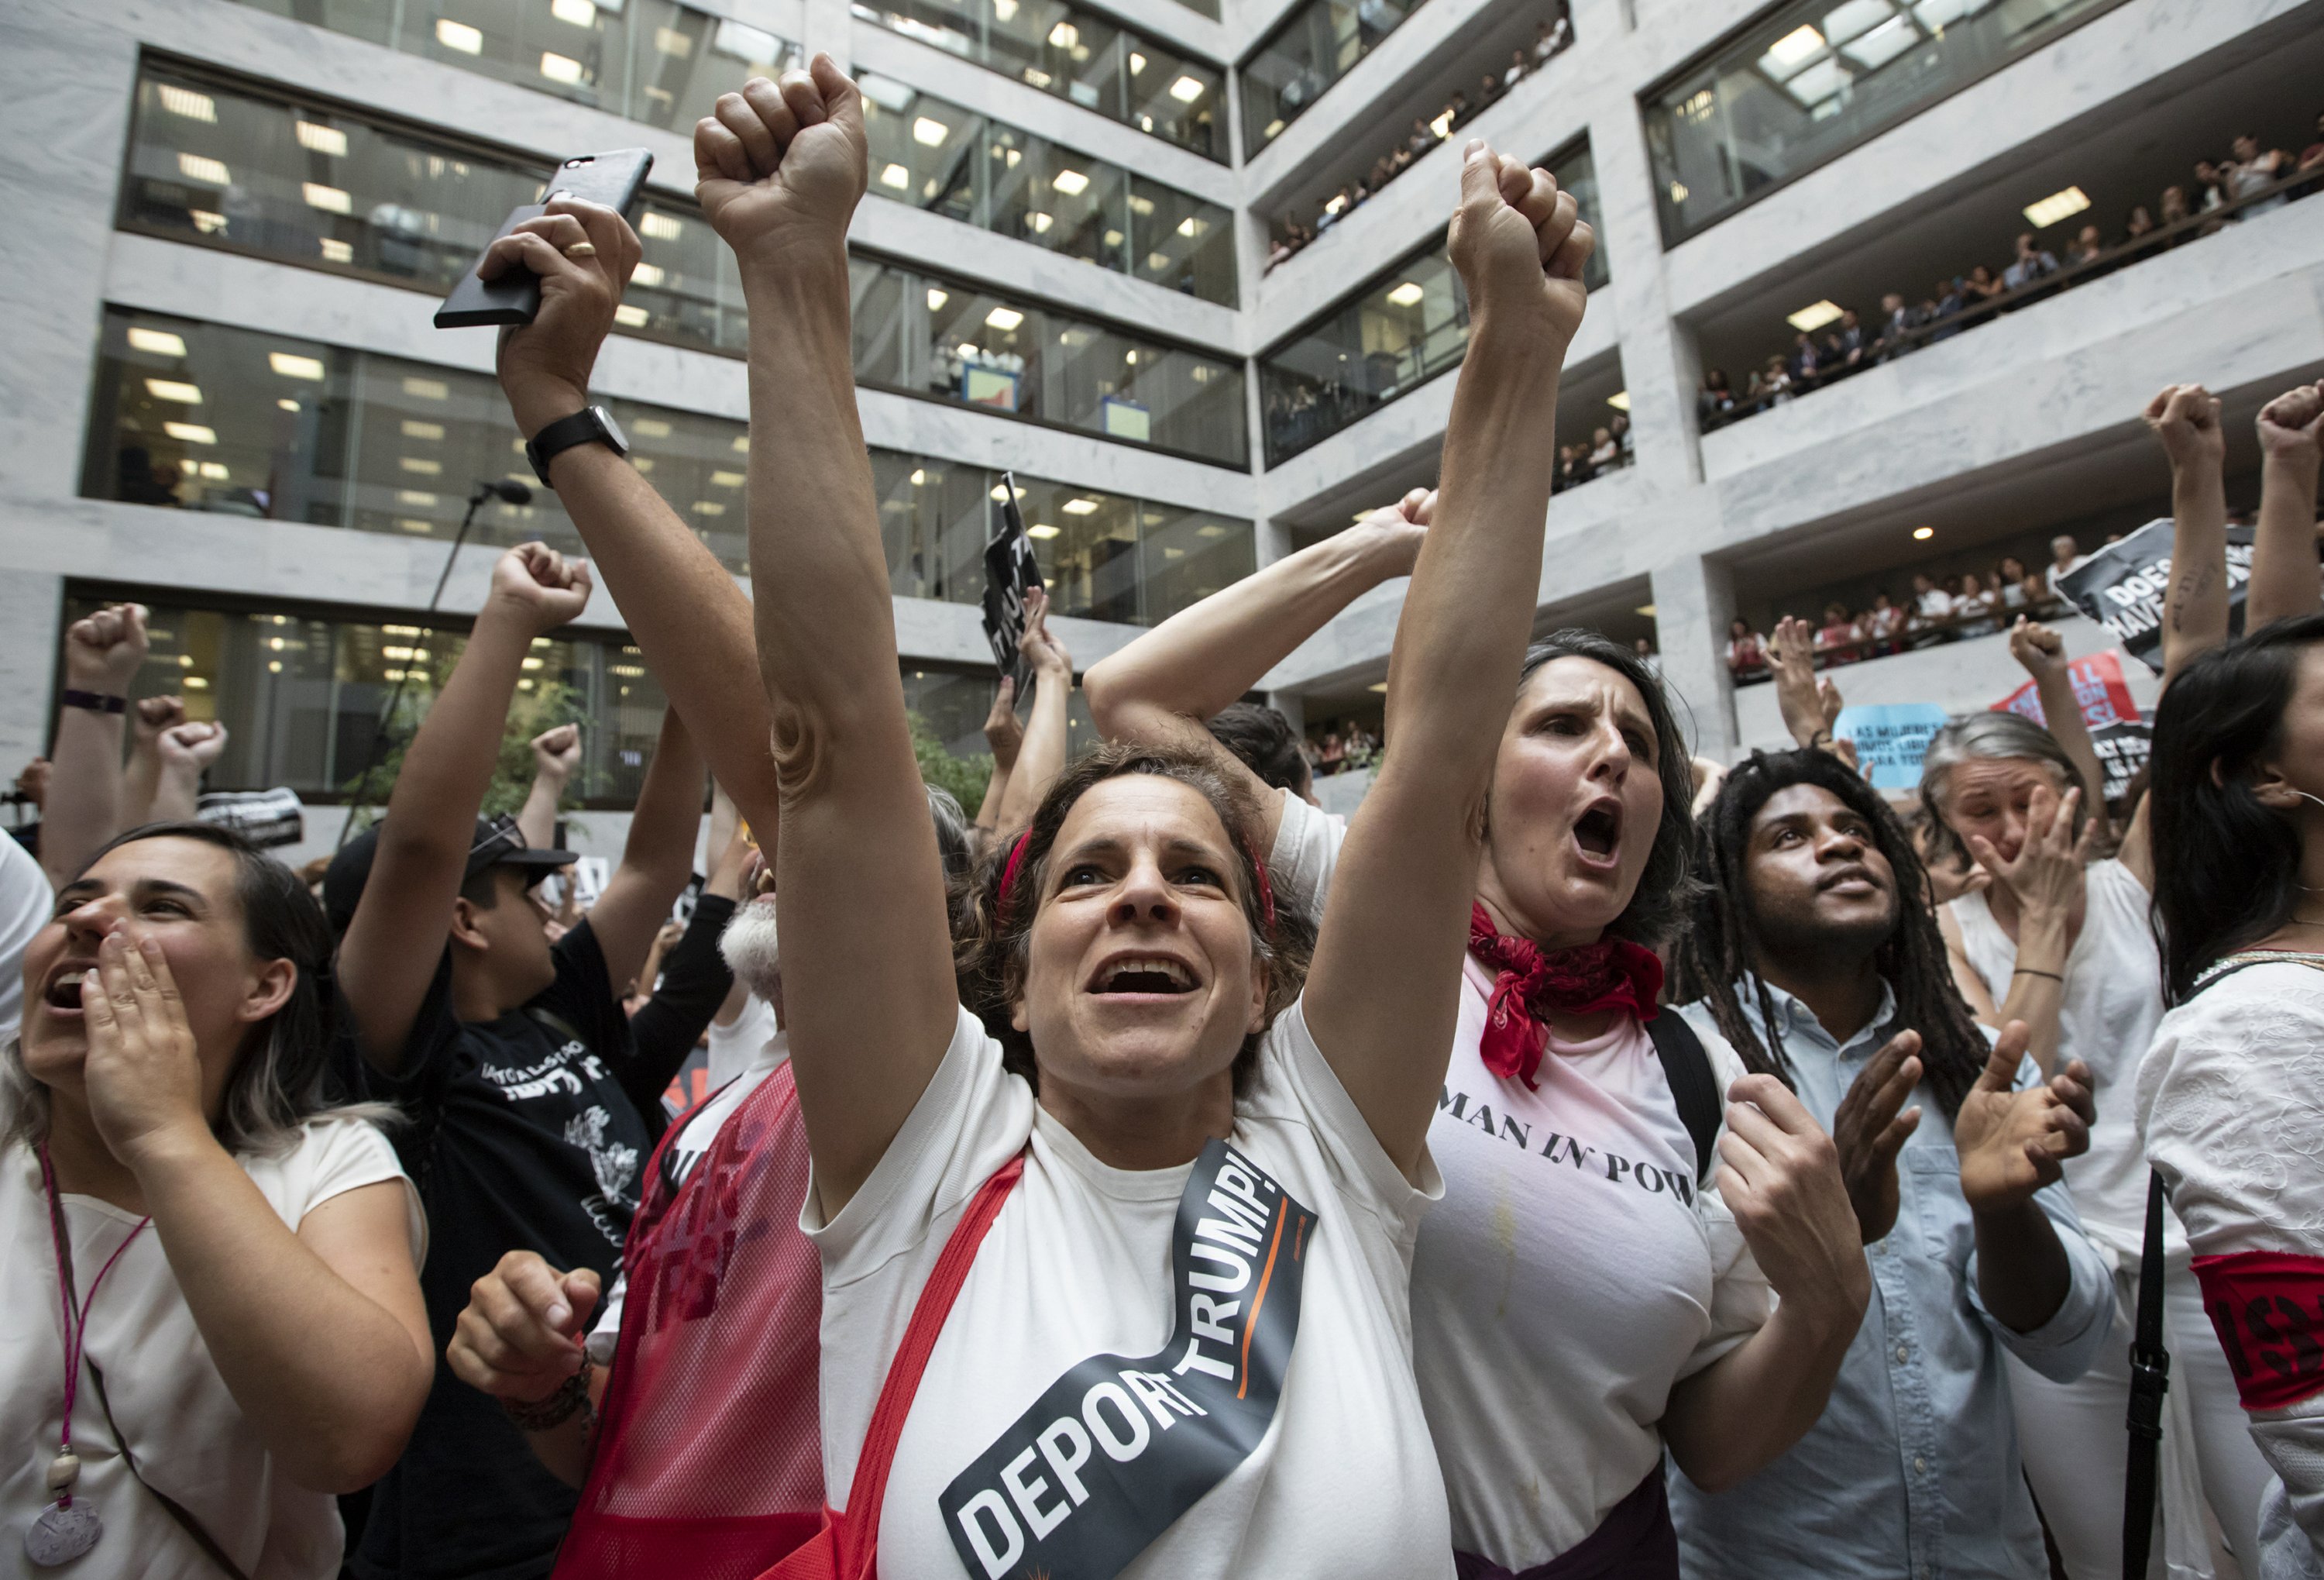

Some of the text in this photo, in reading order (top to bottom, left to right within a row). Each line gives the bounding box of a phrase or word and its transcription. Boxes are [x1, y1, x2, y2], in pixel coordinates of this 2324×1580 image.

[2105, 559, 2171, 607] DOES
[2103, 594, 2166, 642] HAVE
[1539, 1131, 1596, 1169] IN
[956, 1151, 1277, 1580] DEPORT TRUMP!
